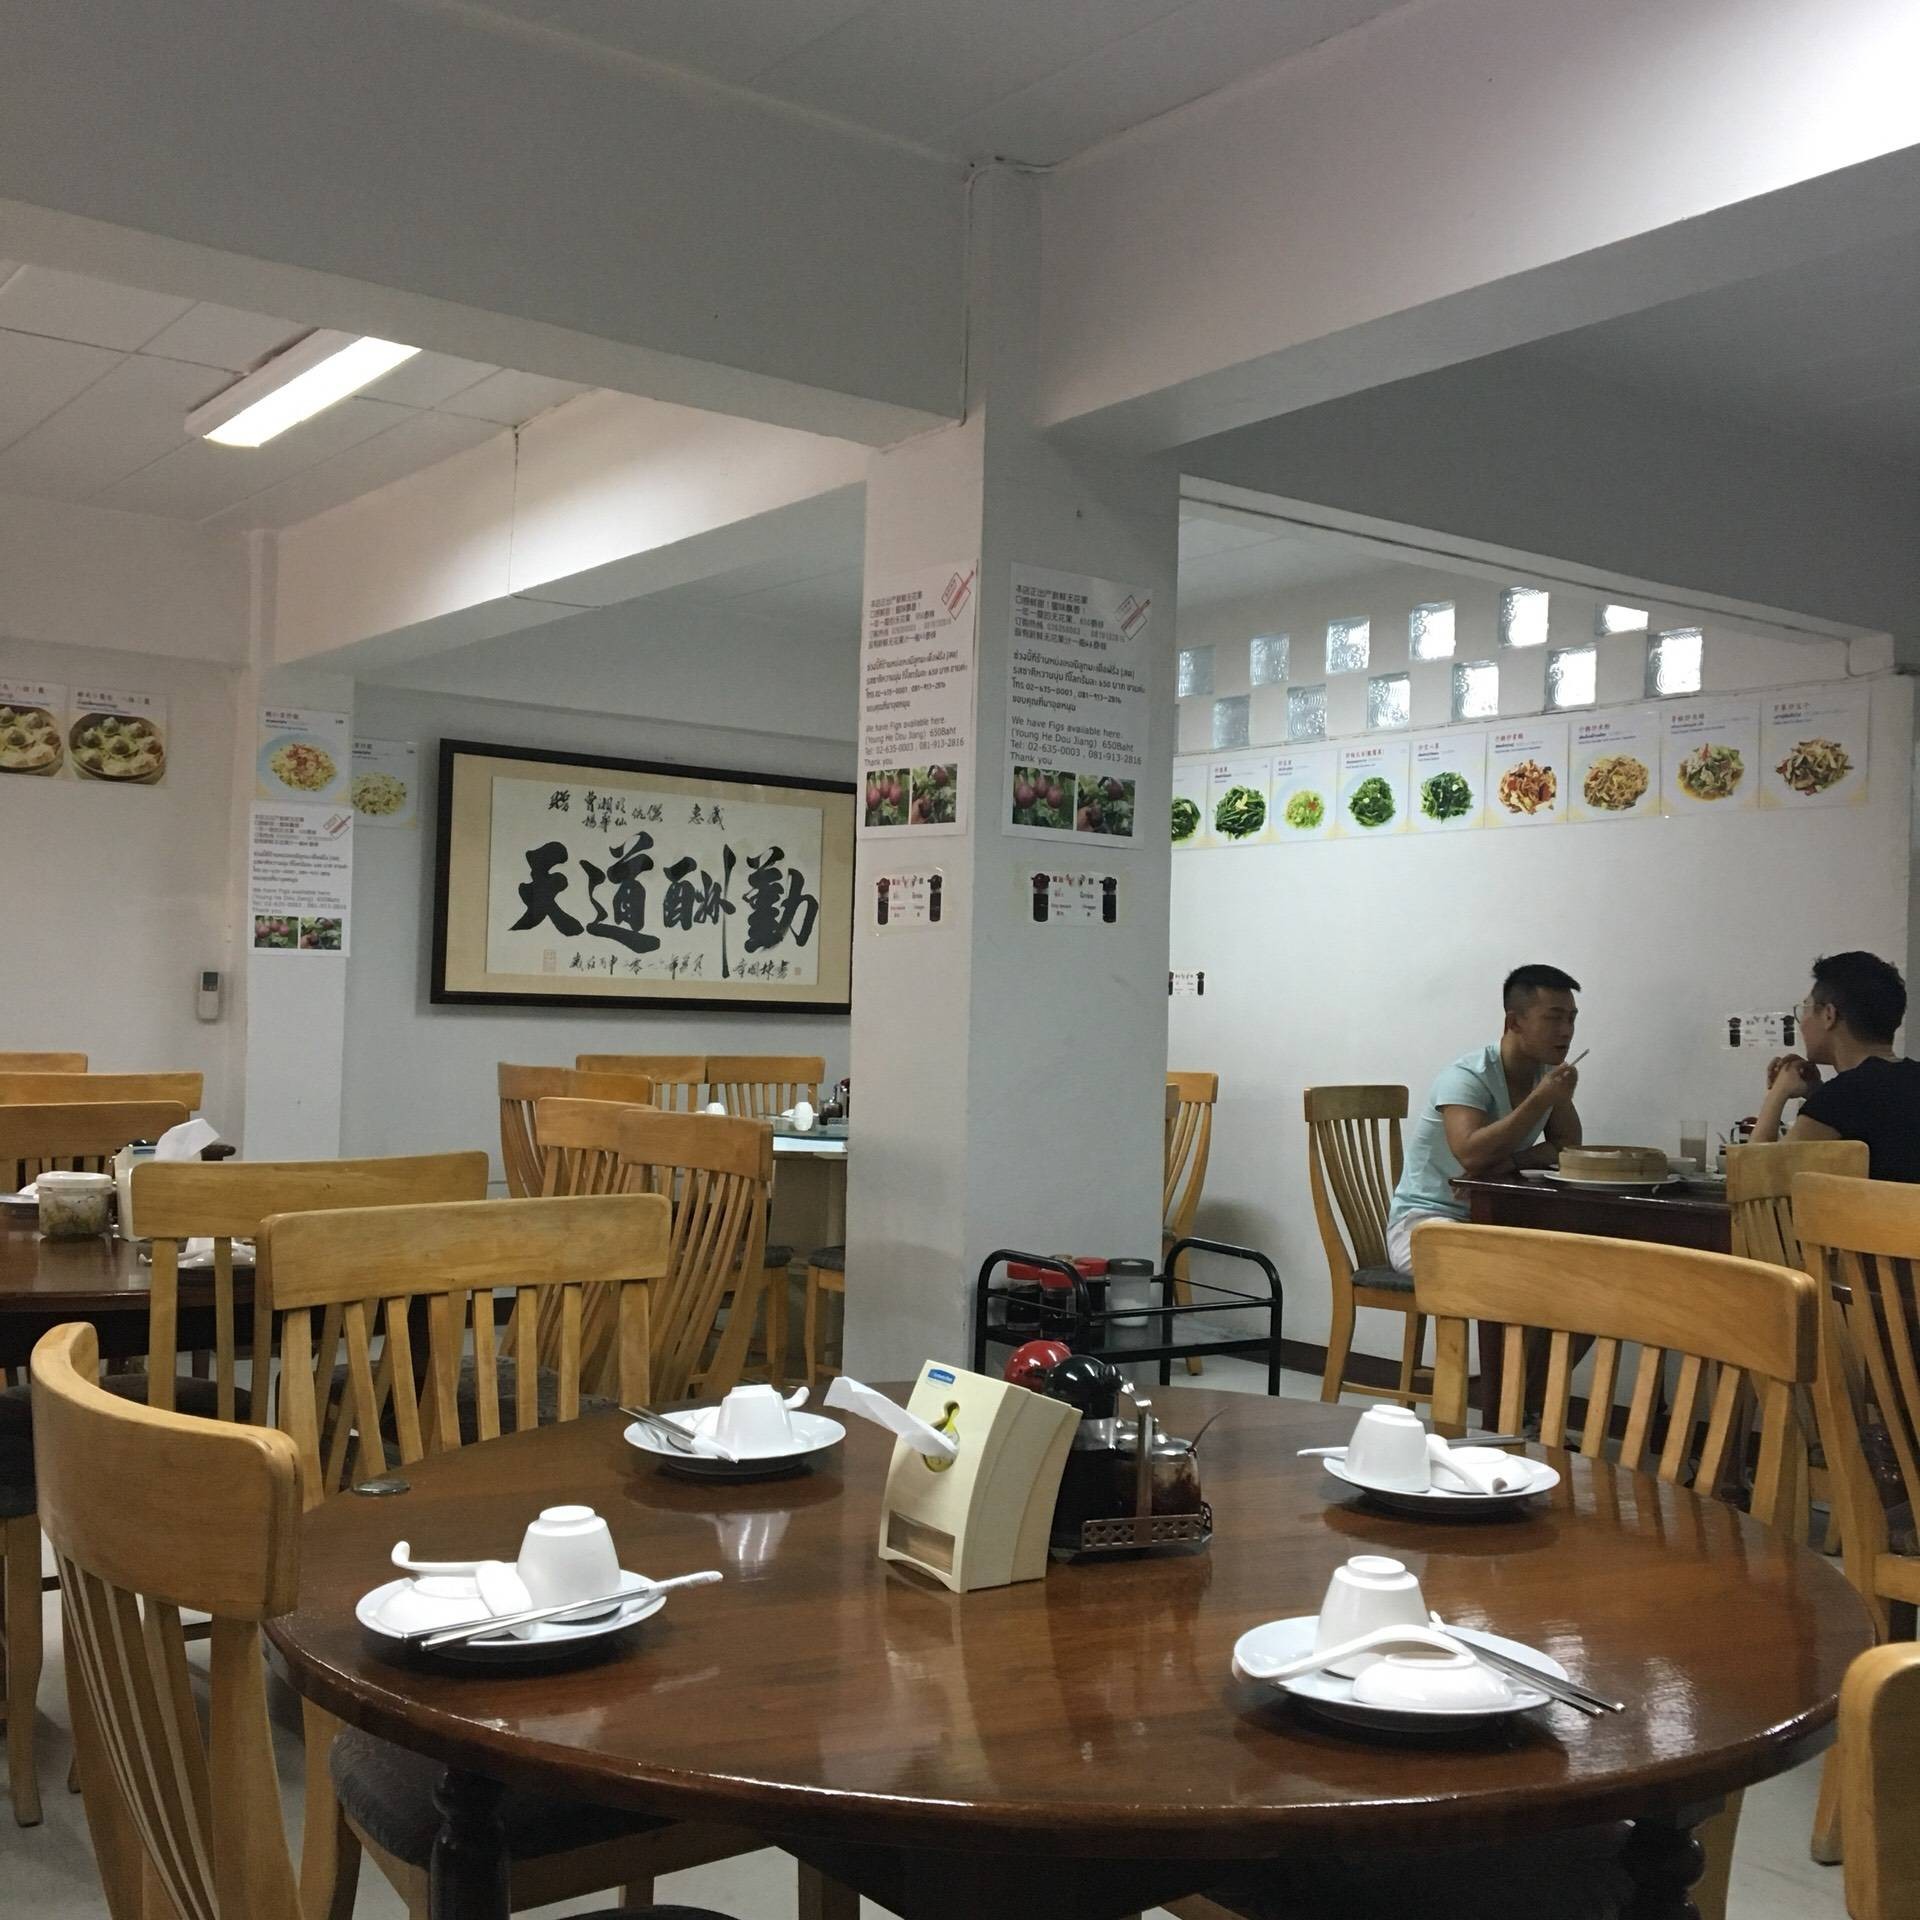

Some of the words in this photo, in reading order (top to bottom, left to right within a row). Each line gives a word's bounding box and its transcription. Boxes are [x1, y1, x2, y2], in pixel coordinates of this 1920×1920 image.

[1011, 715, 1025, 725] We
[1026, 718, 1046, 729] have
[1048, 720, 1065, 733] Figs
[1066, 724, 1101, 737] available
[1010, 739, 1025, 750] Tel:
[1027, 742, 1081, 758] 02-635-0003
[1087, 749, 1143, 766] 081-913-2816
[1011, 727, 1040, 742] (Young
[1042, 731, 1053, 742] He
[1055, 733, 1071, 745] Dou
[1073, 735, 1098, 749] Jiang)
[1101, 740, 1134, 753] 650Baht
[1009, 751, 1035, 763] Thank
[1037, 756, 1053, 766] you
[507, 830, 819, 980] 天道酬勤
